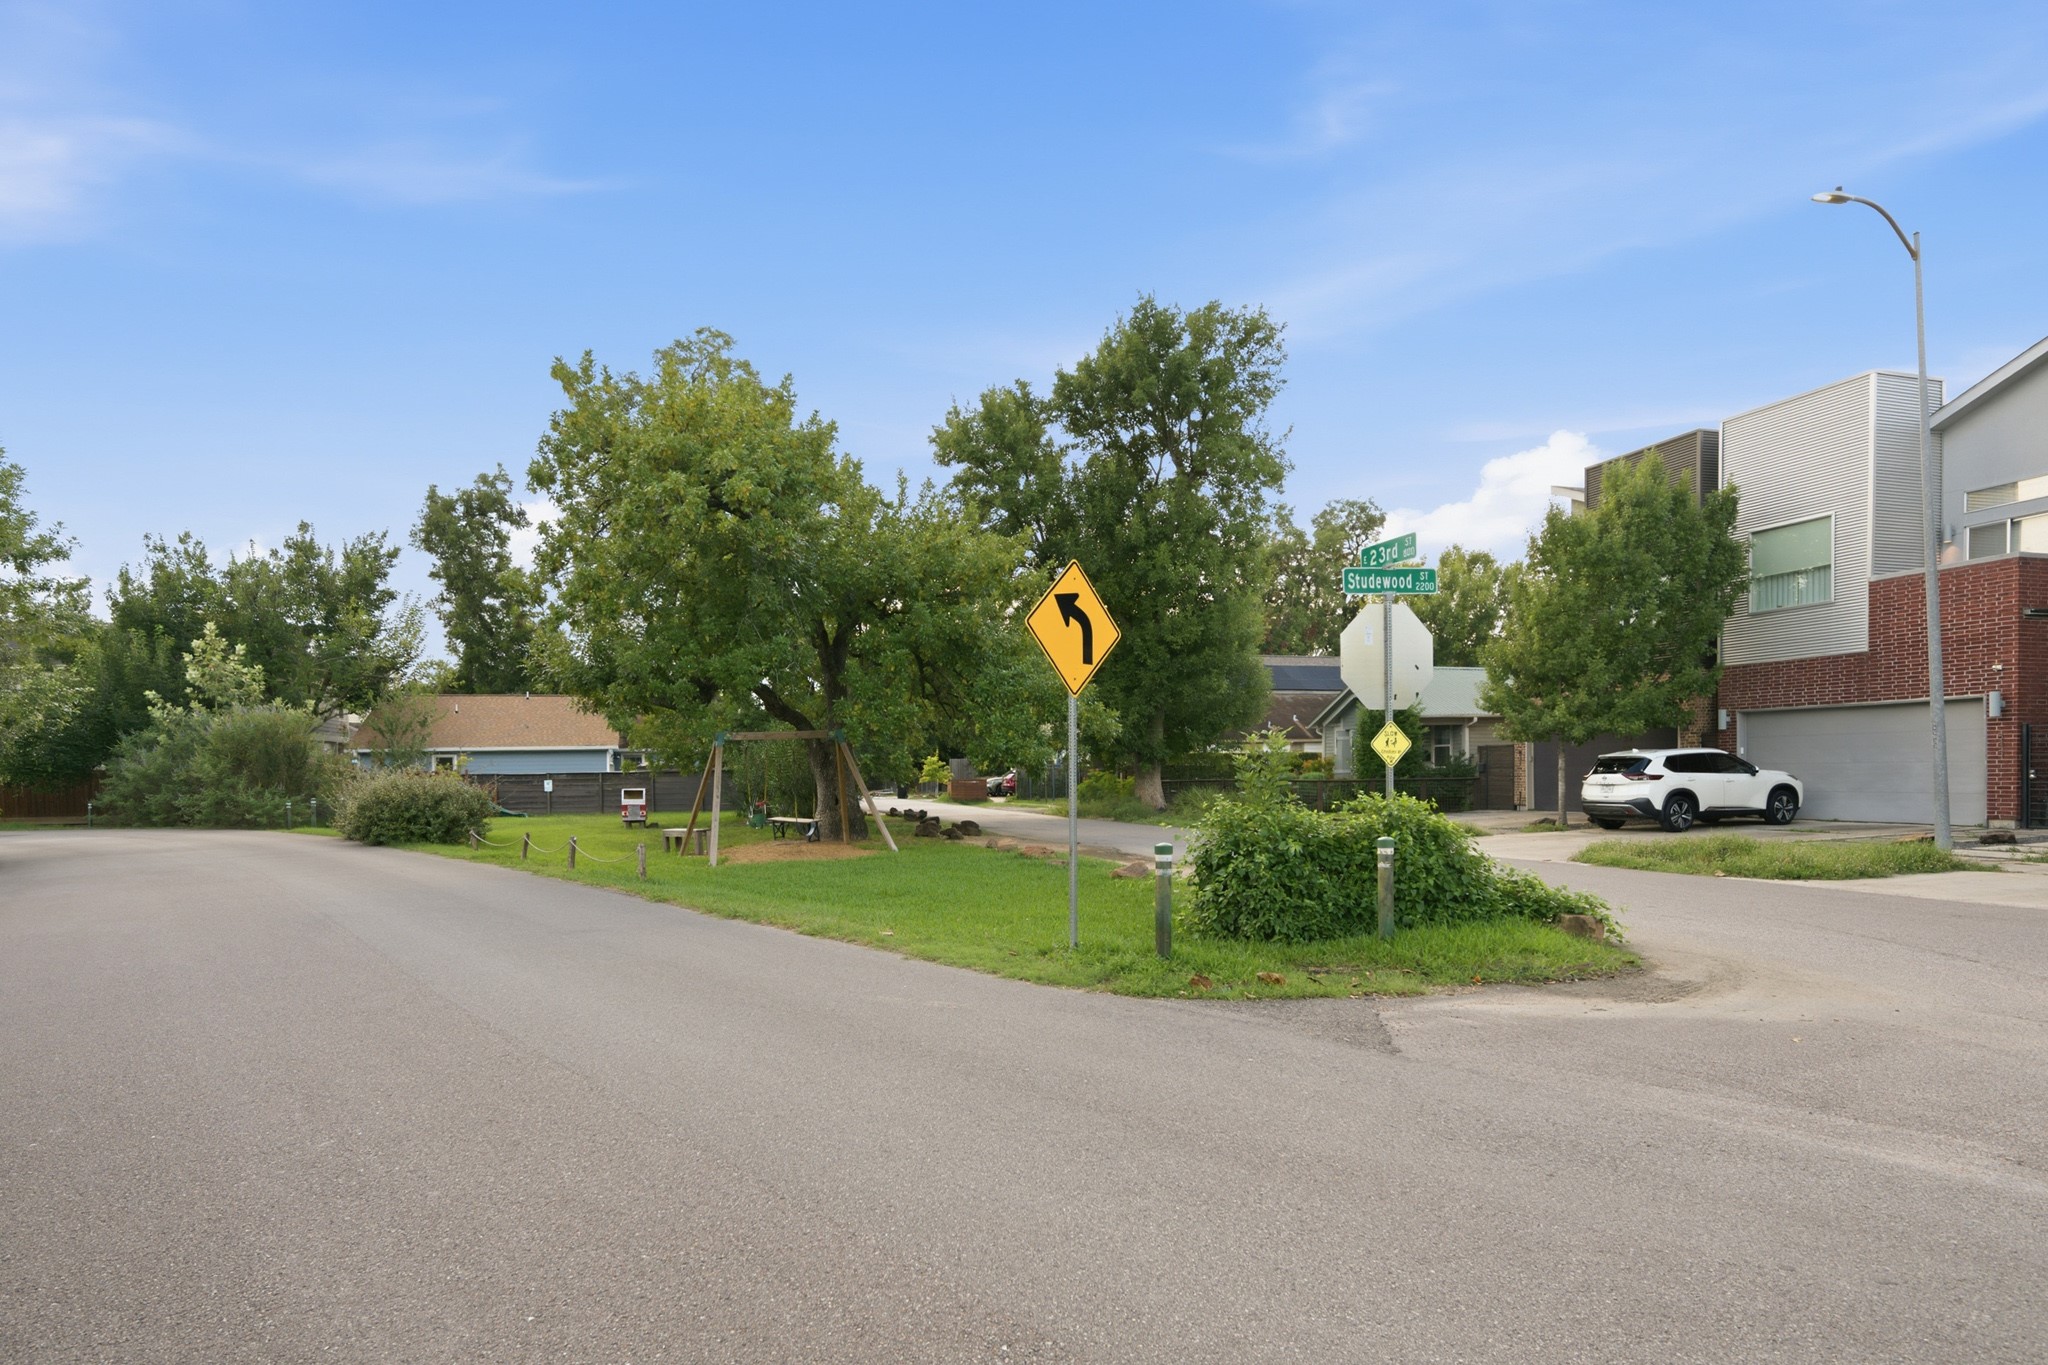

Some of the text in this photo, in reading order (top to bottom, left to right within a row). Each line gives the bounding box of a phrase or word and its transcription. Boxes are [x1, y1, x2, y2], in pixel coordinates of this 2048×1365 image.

[1363, 537, 1412, 566] E 23rd ST
[1347, 571, 1429, 589] Studewood ST
[1415, 582, 1435, 591] 2200
